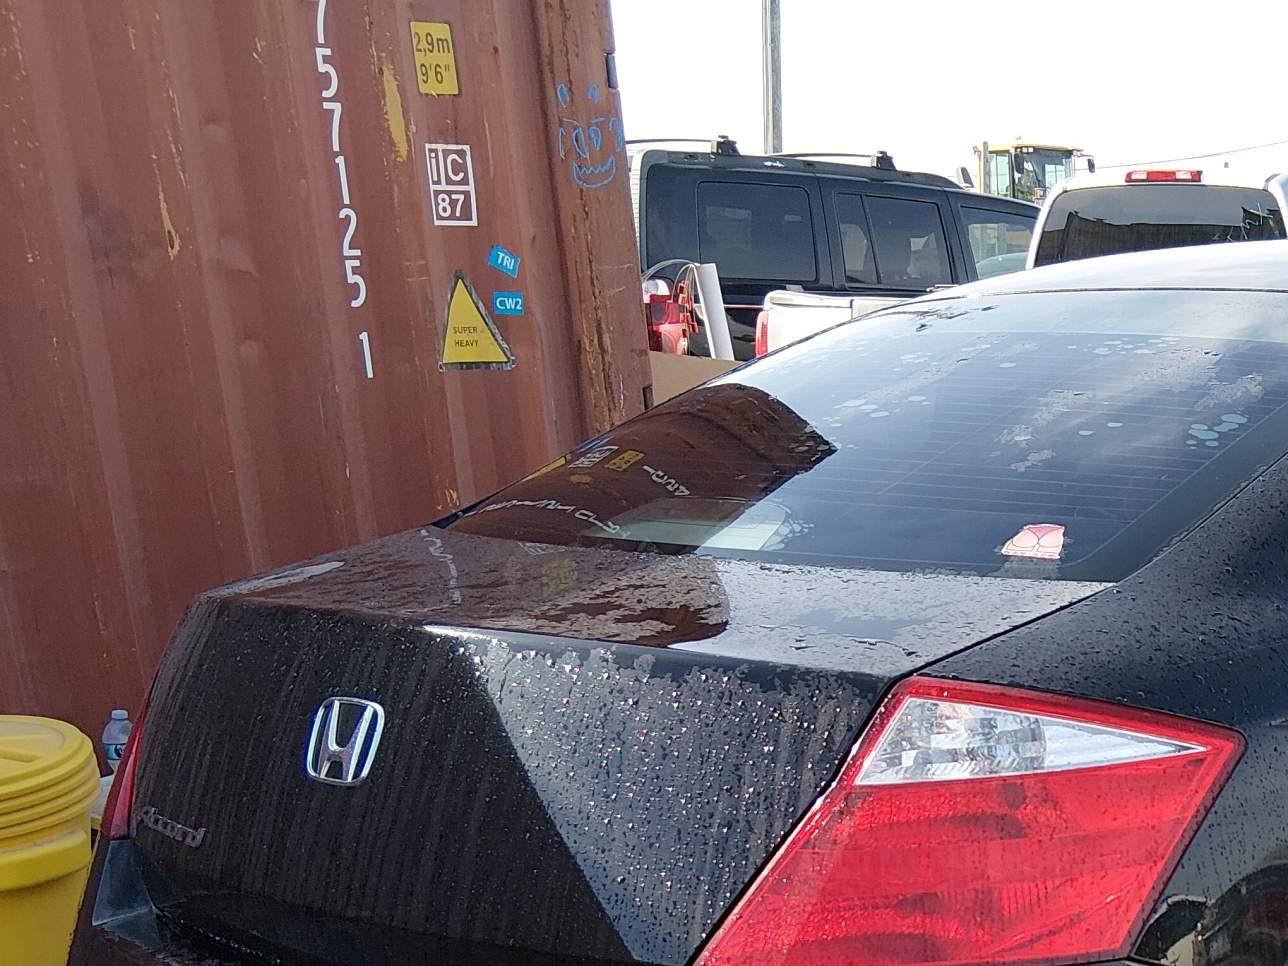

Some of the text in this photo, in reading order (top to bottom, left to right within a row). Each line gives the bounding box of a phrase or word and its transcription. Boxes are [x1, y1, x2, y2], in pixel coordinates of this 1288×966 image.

[437, 193, 465, 217] 87
[497, 251, 515, 270] TRI
[496, 297, 523, 311] CW2
[453, 326, 478, 335] SUPER
[455, 339, 479, 347] HEAVY
